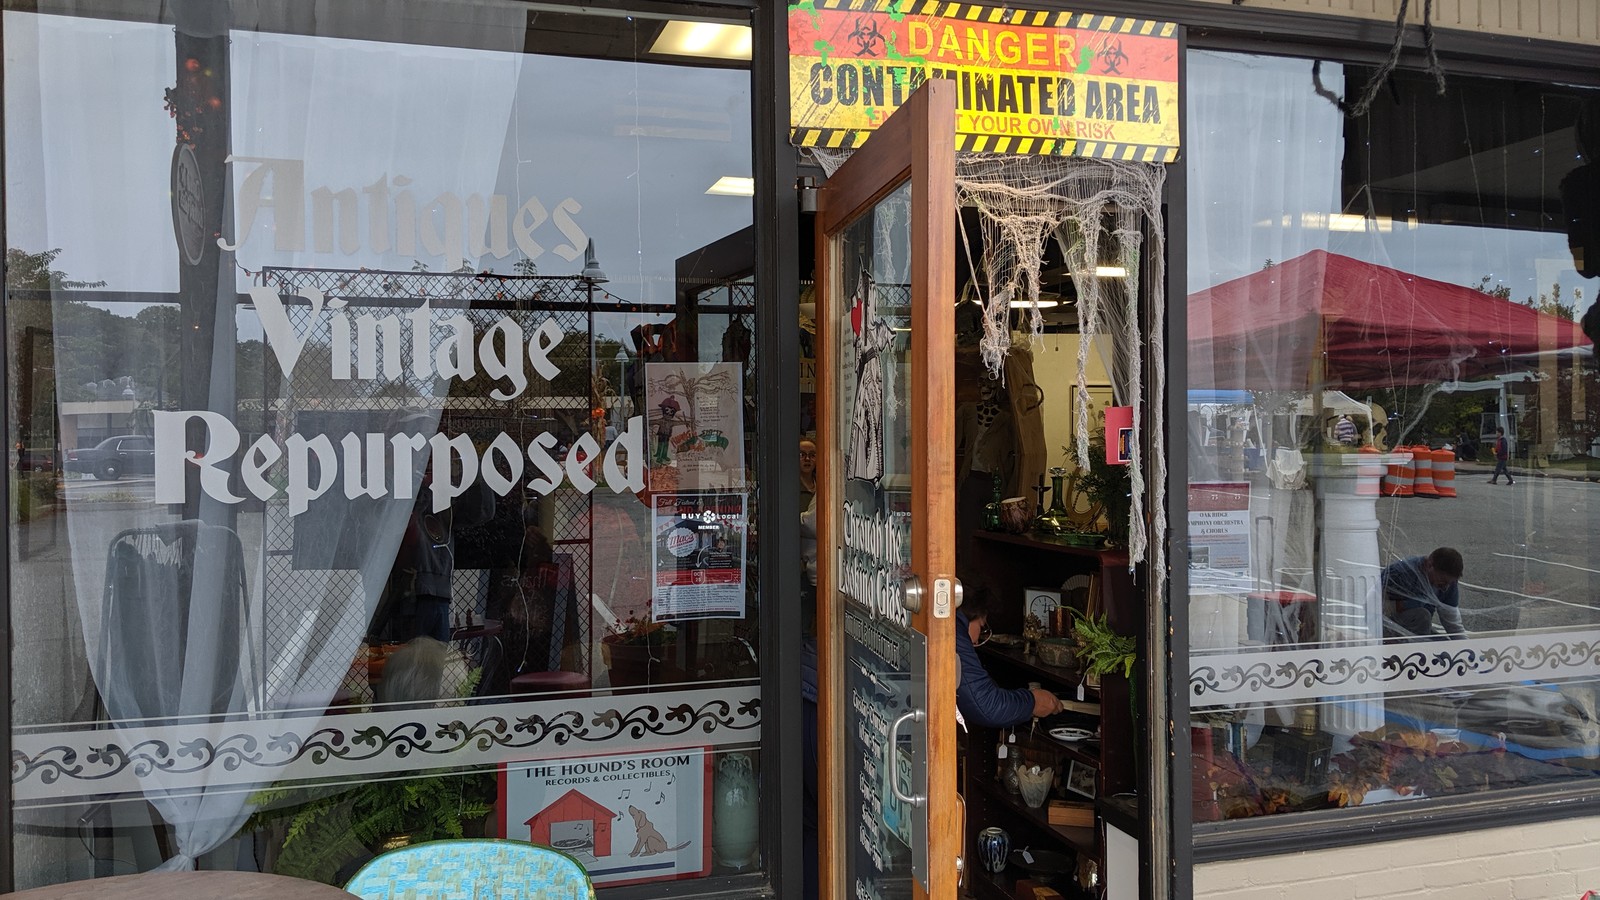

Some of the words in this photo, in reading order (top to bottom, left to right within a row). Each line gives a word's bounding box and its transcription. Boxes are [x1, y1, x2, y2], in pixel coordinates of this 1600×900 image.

[908, 21, 1077, 69] DANGER
[969, 114, 1022, 134] YOUR
[1027, 117, 1071, 138] OWN
[1076, 121, 1116, 140] RISK
[1085, 80, 1162, 125] AREA
[217, 154, 588, 272] Antiques
[248, 285, 566, 401] Vintage
[152, 409, 647, 518] Repurposed
[843, 500, 881, 569] Through
[884, 509, 902, 567] the
[876, 564, 907, 630] Glass
[526, 765, 556, 778] THE
[561, 759, 636, 776] HOUND'S
[641, 755, 690, 769] ROOM
[545, 776, 590, 786] RECORDS
[602, 769, 671, 782] COLLECTIBLES
